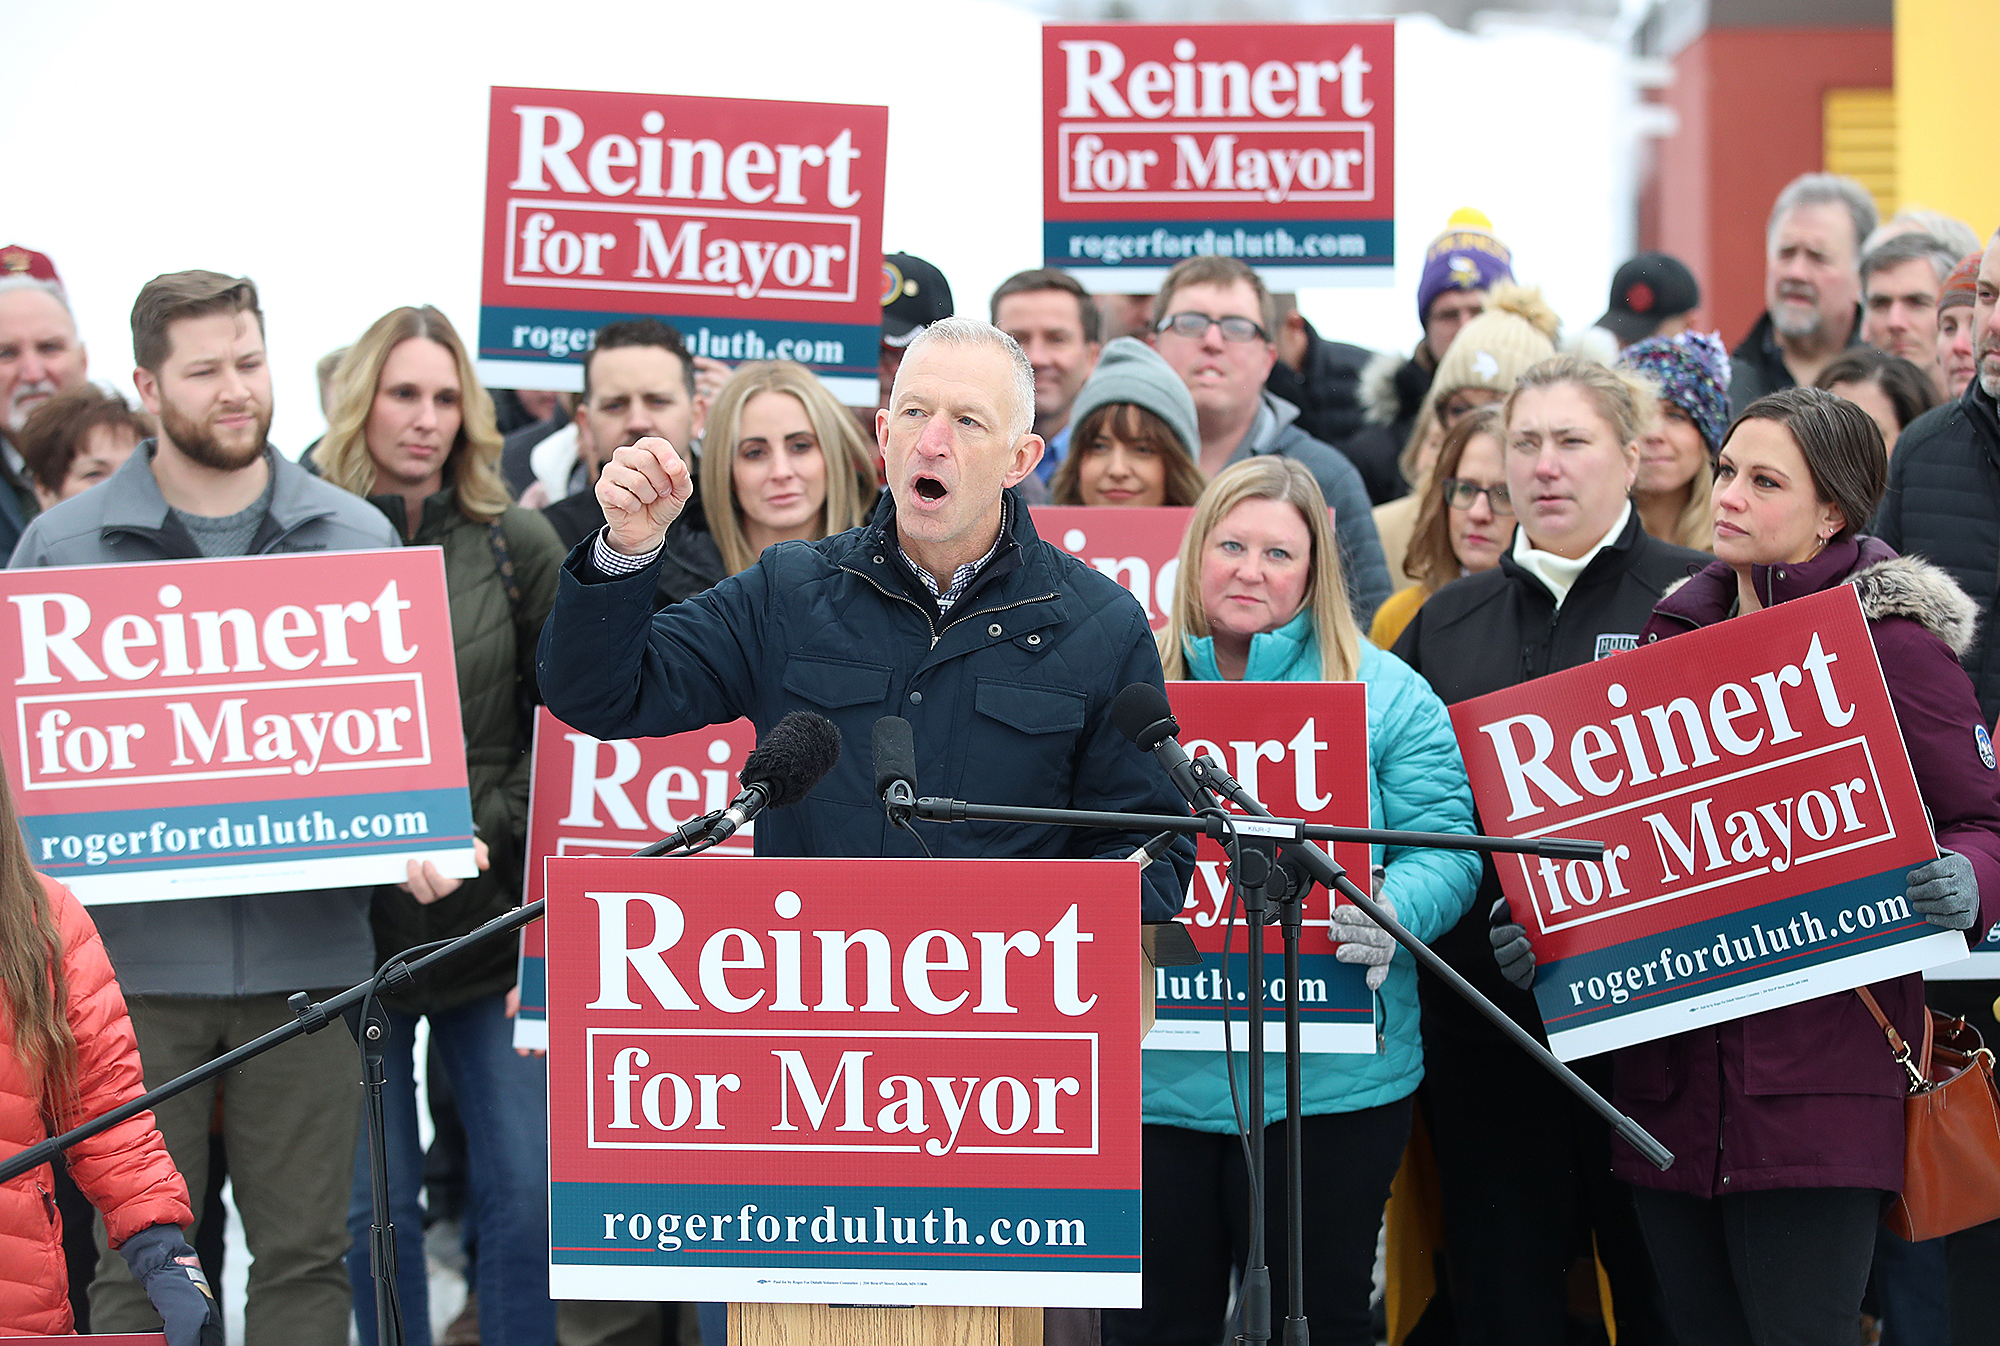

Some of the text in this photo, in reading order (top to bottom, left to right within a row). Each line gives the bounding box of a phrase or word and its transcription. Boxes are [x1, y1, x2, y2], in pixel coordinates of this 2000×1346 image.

[1059, 39, 1374, 119] Reinert
[510, 105, 862, 209] Reinert
[1072, 135, 1367, 203] for Mayor
[520, 213, 847, 300] for Mayor
[1068, 227, 1367, 264] rogerforduluth.com
[7, 579, 420, 686] Reinert
[36, 697, 413, 777] for Mayor
[1479, 631, 1857, 823] Reinert
[40, 810, 430, 866] rogerforduluth.com
[1537, 776, 1867, 916] for Mayor
[583, 890, 1099, 1017] Reinert
[1568, 892, 1913, 1007] rogerforduluth.com
[606, 1046, 1081, 1158] for Mayor
[603, 1203, 1088, 1253] rogerforduluth.com
